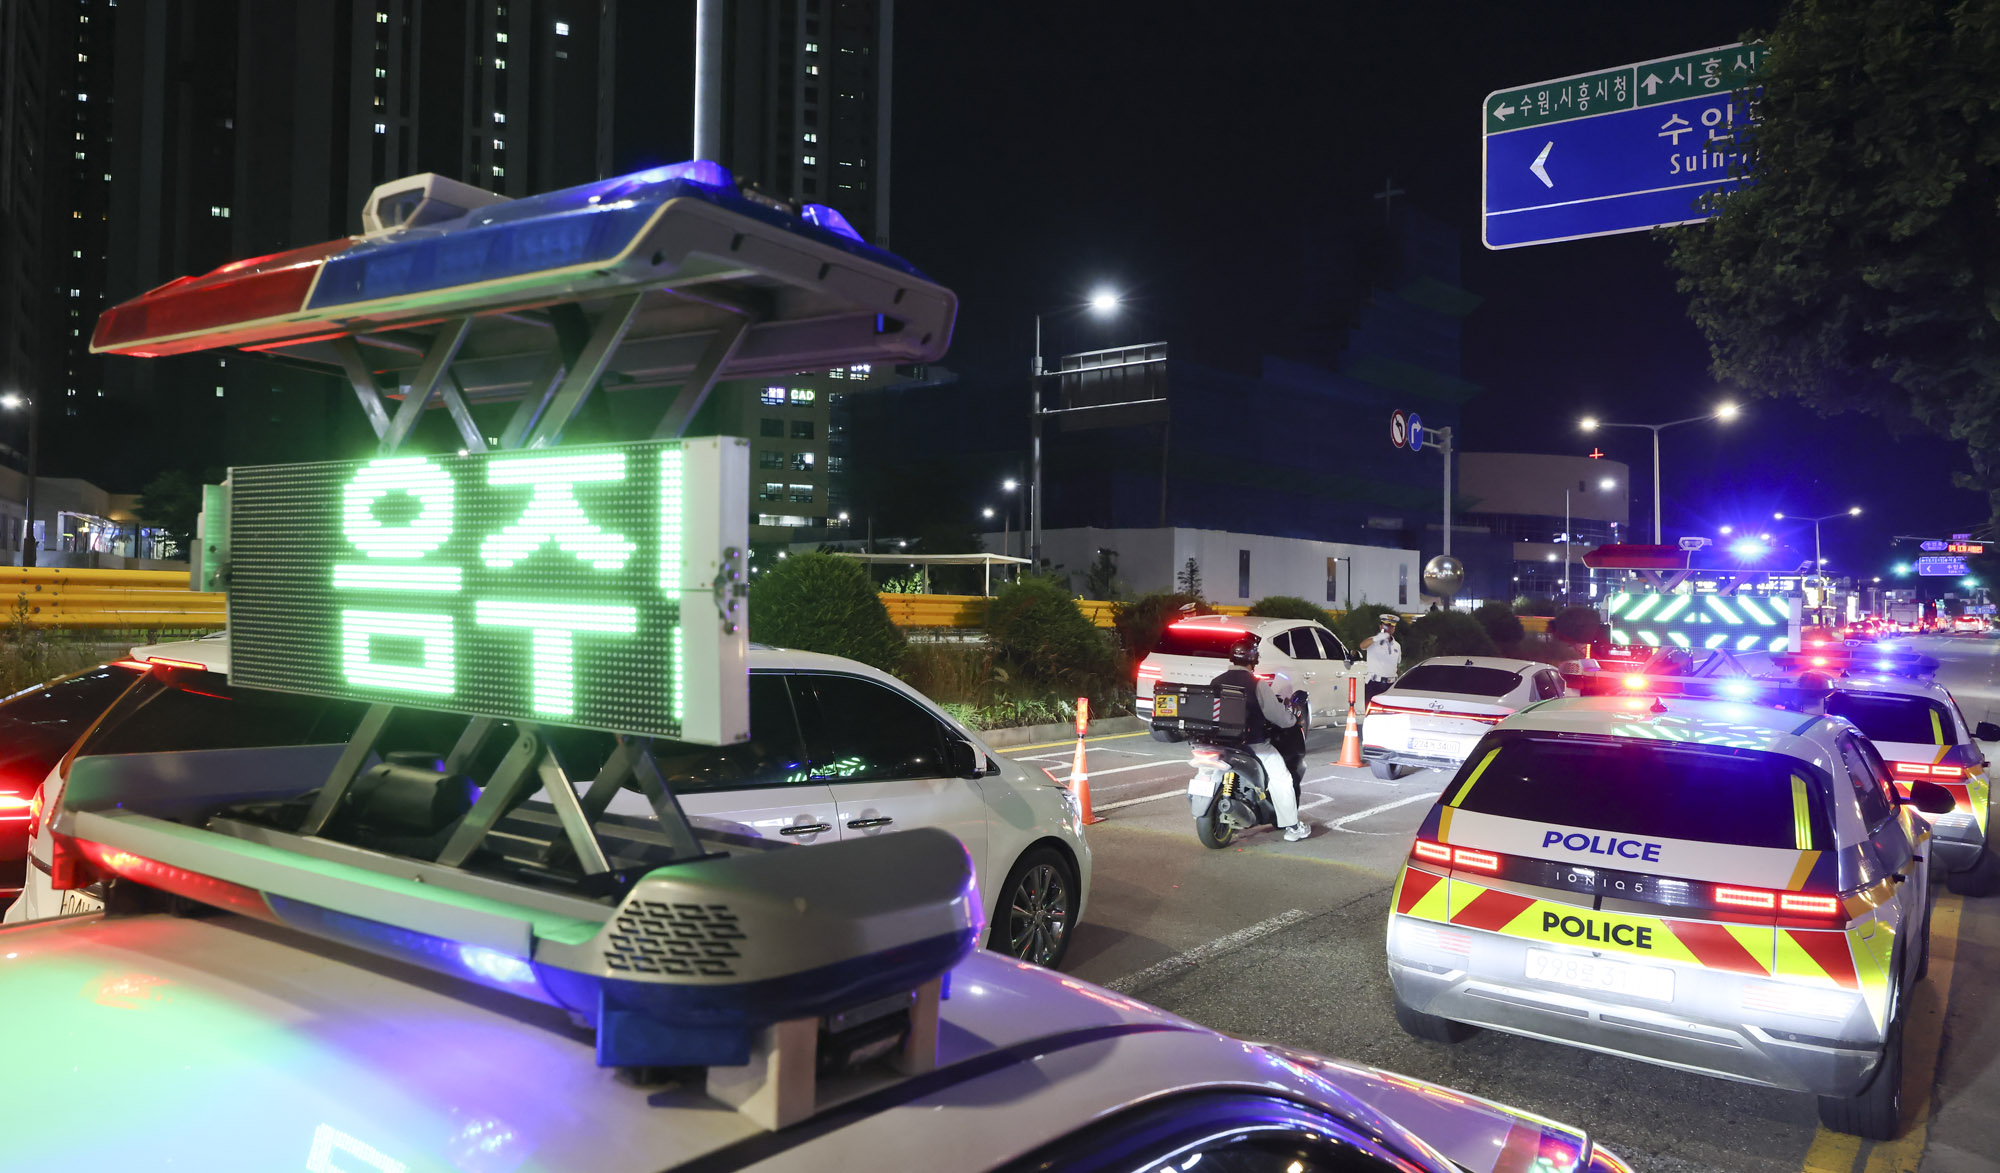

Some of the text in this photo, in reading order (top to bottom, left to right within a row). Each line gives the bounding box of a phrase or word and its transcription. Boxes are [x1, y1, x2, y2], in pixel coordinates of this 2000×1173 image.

[1668, 47, 1773, 88] 시흥시
[1519, 75, 1627, 117] 수원,시흥시청
[790, 389, 815, 401] CAD
[332, 449, 683, 720] 음주
[1542, 830, 1662, 863] POLICE
[1543, 911, 1652, 950] POLICE
